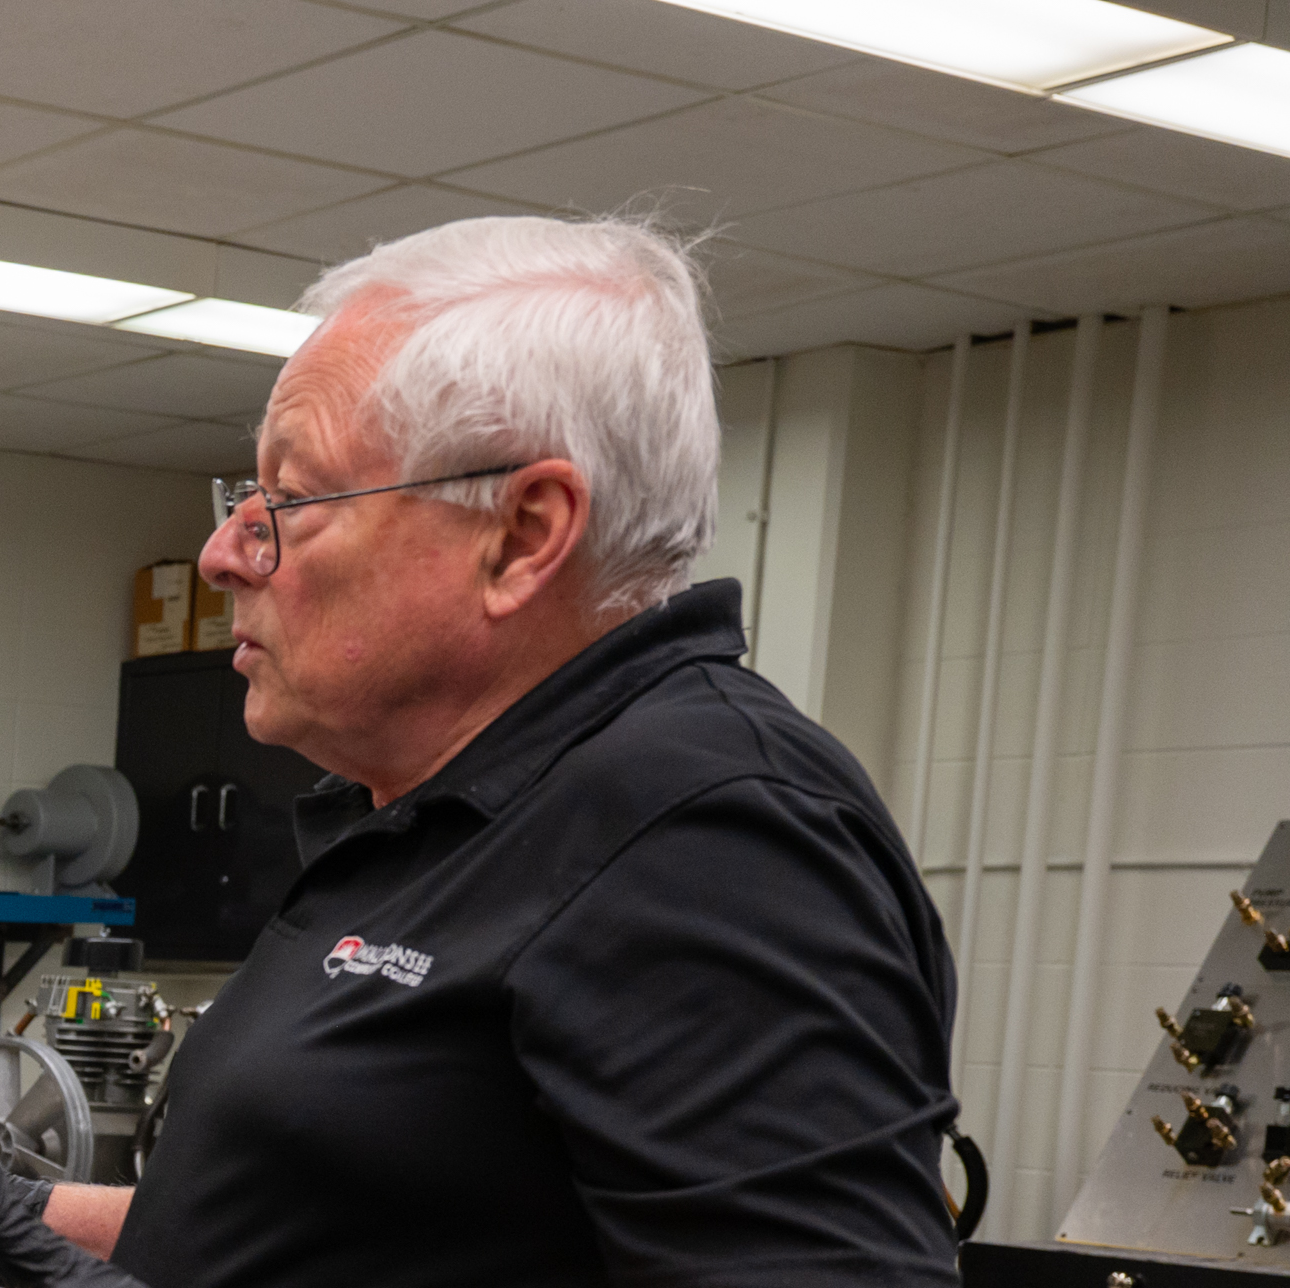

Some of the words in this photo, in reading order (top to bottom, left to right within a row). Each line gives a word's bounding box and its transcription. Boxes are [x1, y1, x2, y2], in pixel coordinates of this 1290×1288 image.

[1147, 1082, 1200, 1095] REDUCING
[1162, 1169, 1200, 1180] RELIEF
[1202, 1173, 1237, 1185] VALVE
